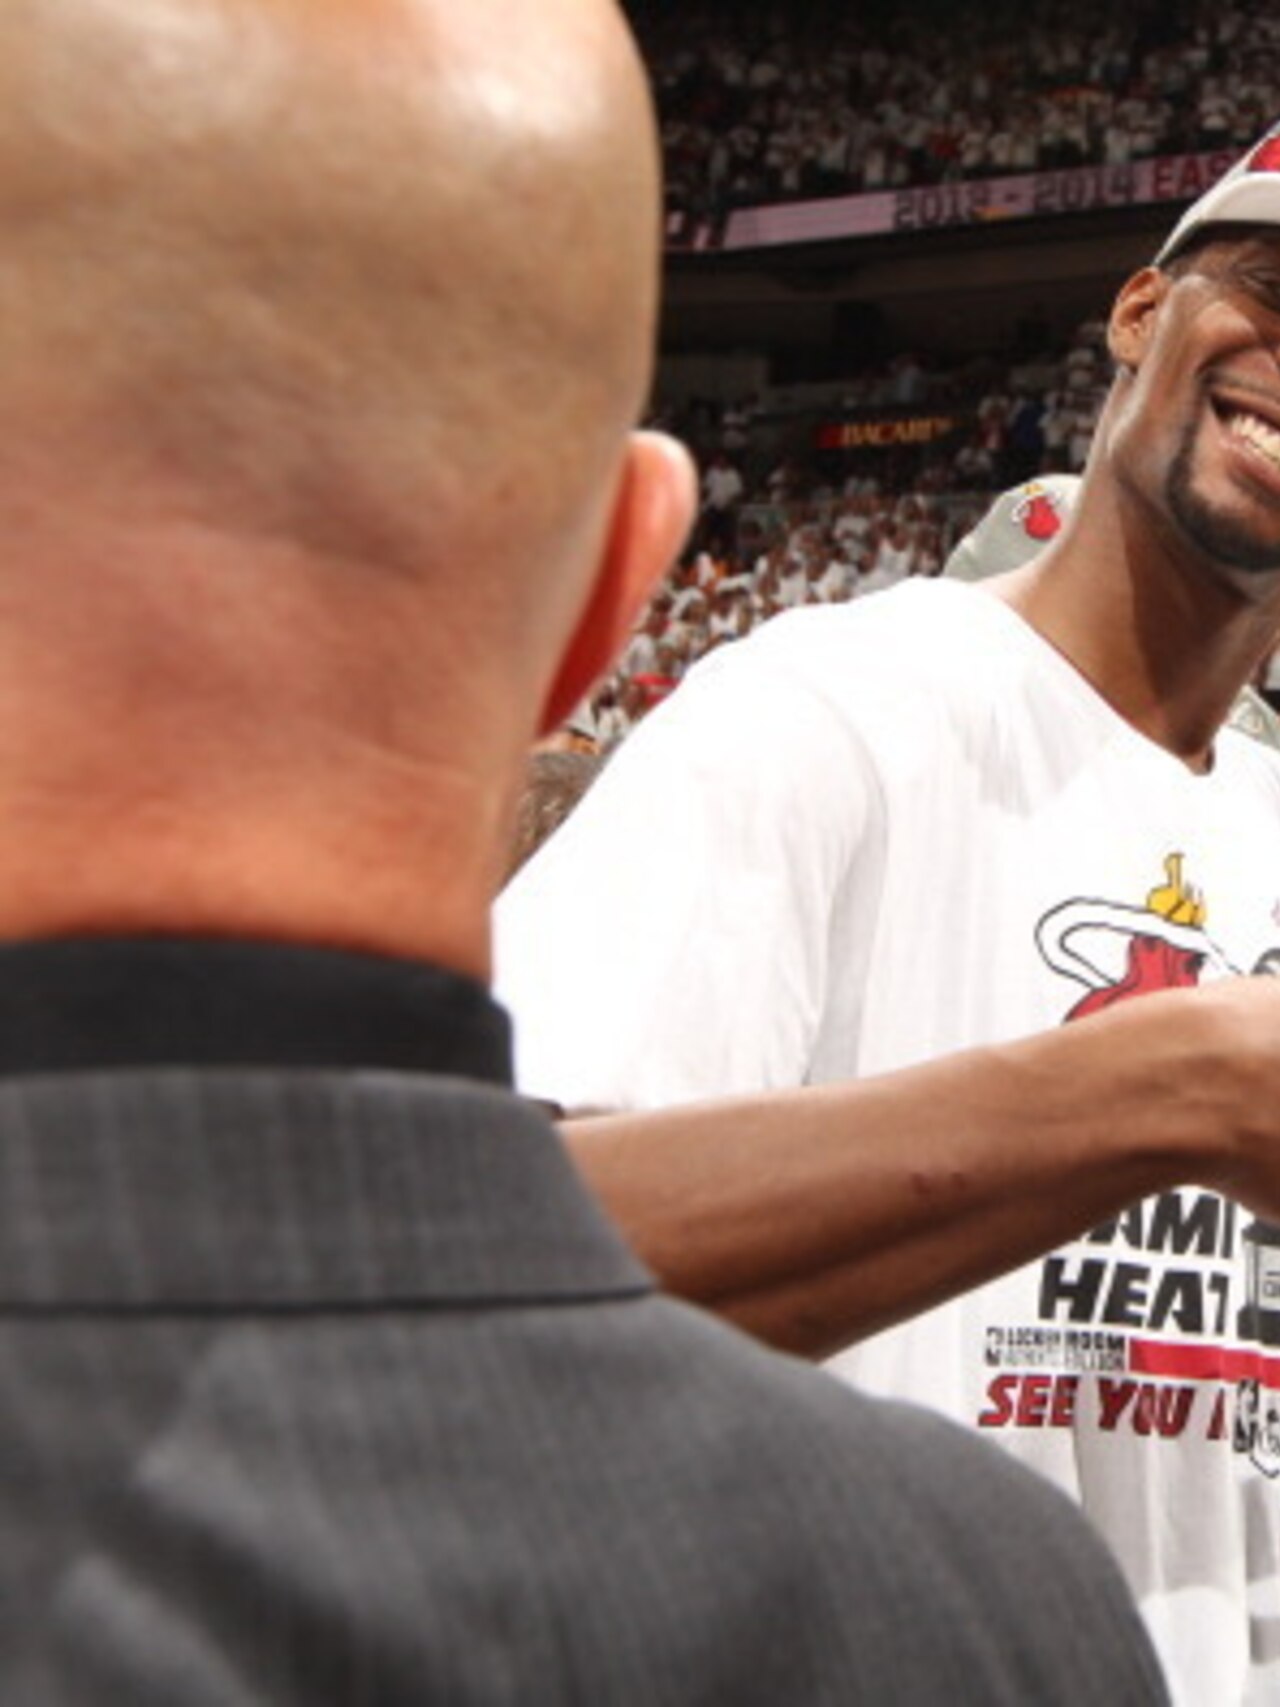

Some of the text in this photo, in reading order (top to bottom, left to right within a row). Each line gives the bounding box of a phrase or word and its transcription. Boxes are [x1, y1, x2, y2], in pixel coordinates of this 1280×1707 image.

[1087, 1193, 1238, 1259] AMI
[1038, 1257, 1229, 1336] HEAT
[978, 1375, 1079, 1428] SEE
[1096, 1380, 1195, 1438] YOU
